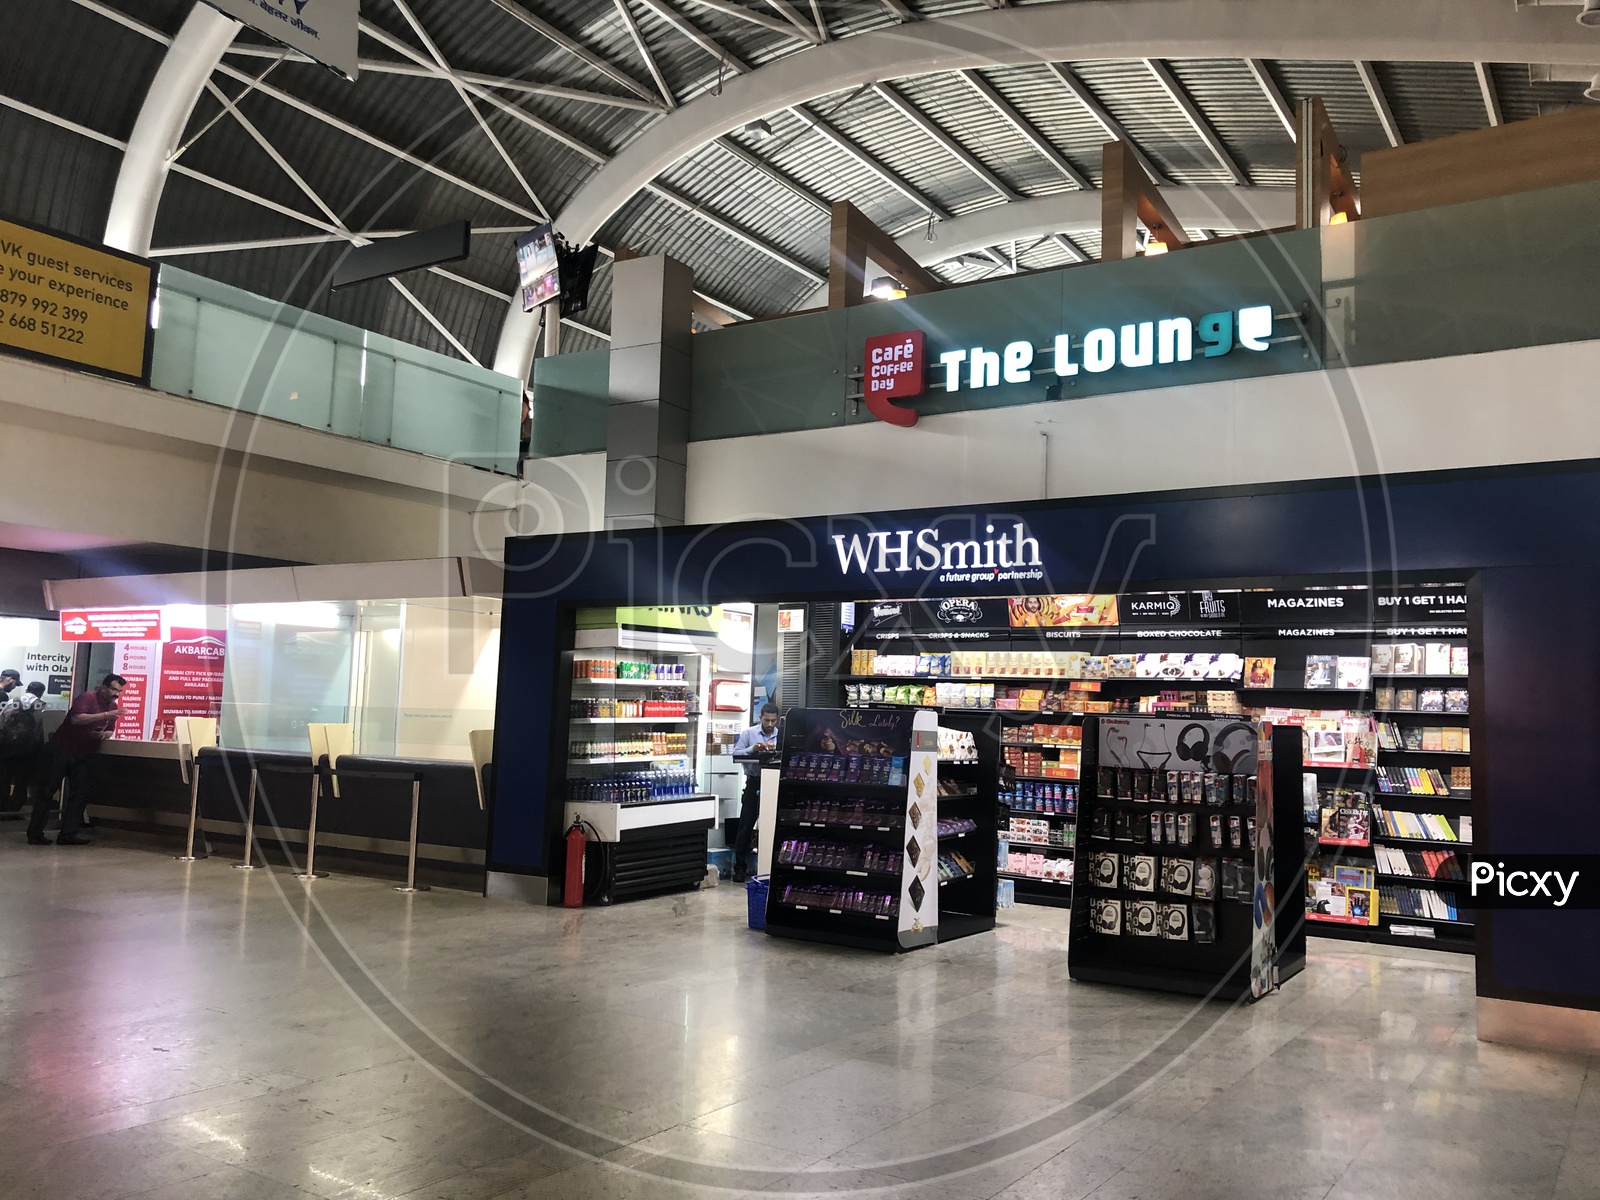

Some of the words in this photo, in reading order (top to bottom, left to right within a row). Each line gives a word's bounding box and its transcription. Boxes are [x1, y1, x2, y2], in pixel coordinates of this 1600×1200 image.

[27, 250, 69, 274] guest
[73, 265, 133, 292] services
[9, 266, 44, 286] your
[48, 277, 129, 311] experience
[31, 297, 58, 317] 992
[62, 306, 88, 324] 399
[9, 313, 36, 331] 668
[41, 322, 84, 344] 51222
[872, 338, 914, 364] Café
[871, 361, 913, 378] Coffee
[940, 340, 1034, 392] The
[871, 378, 894, 391] Day
[831, 523, 1043, 575] WHSmith
[946, 572, 970, 582] future
[971, 572, 995, 583] group
[997, 569, 1043, 582] partnership
[942, 599, 975, 611] OPERA
[1131, 601, 1175, 610] KARMIQ
[1199, 600, 1226, 614] FRUITS
[1267, 597, 1344, 609] MAGAZINES
[1377, 596, 1402, 606] BUY
[1404, 596, 1410, 605] 1
[1411, 595, 1436, 605] GET
[1438, 595, 1443, 605] 1
[1278, 628, 1335, 637] MAGAZINES
[124, 643, 130, 651] 4
[27, 652, 71, 664] Intercity
[123, 653, 128, 661] 6
[26, 663, 49, 672] with
[51, 664, 68, 673] Ola
[839, 710, 867, 729] Silk
